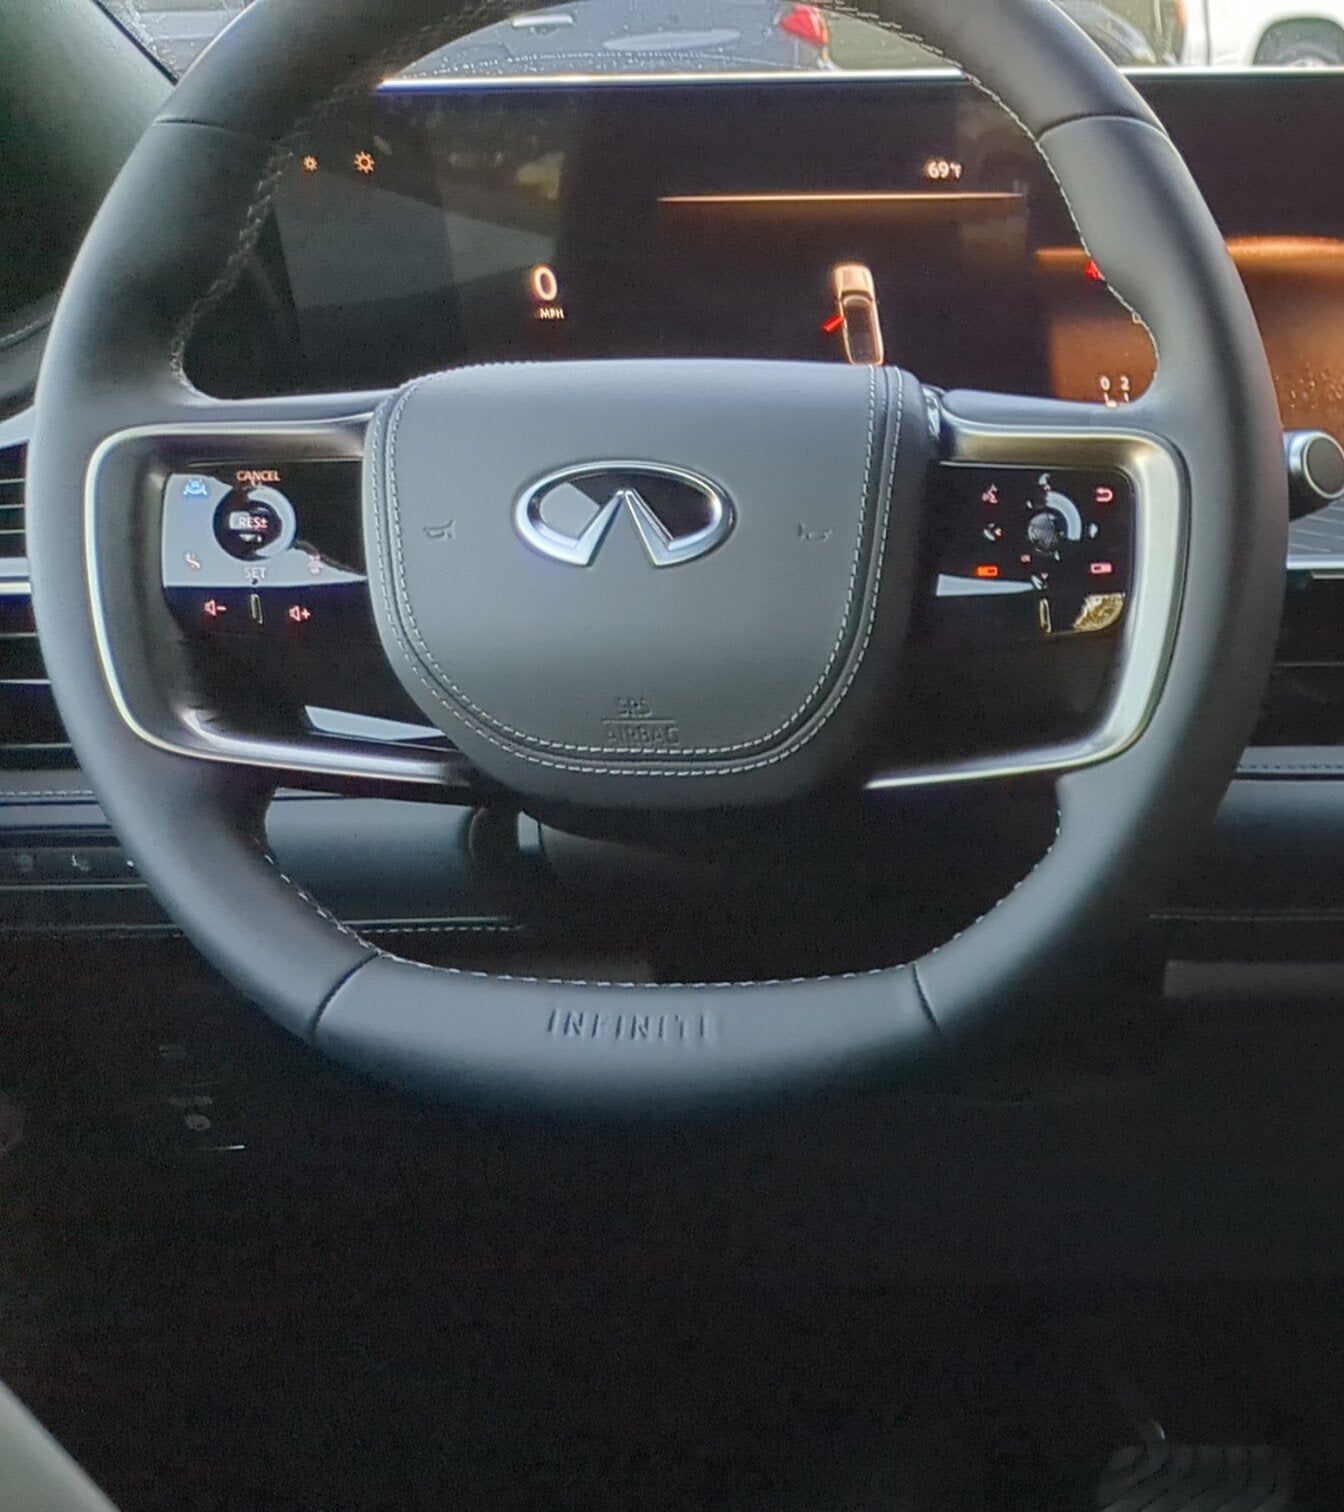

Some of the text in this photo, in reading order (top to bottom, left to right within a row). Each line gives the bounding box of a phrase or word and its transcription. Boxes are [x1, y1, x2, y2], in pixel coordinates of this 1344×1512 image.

[533, 265, 558, 301] 0
[540, 307, 565, 320] MPH
[236, 470, 281, 483] CANCEL
